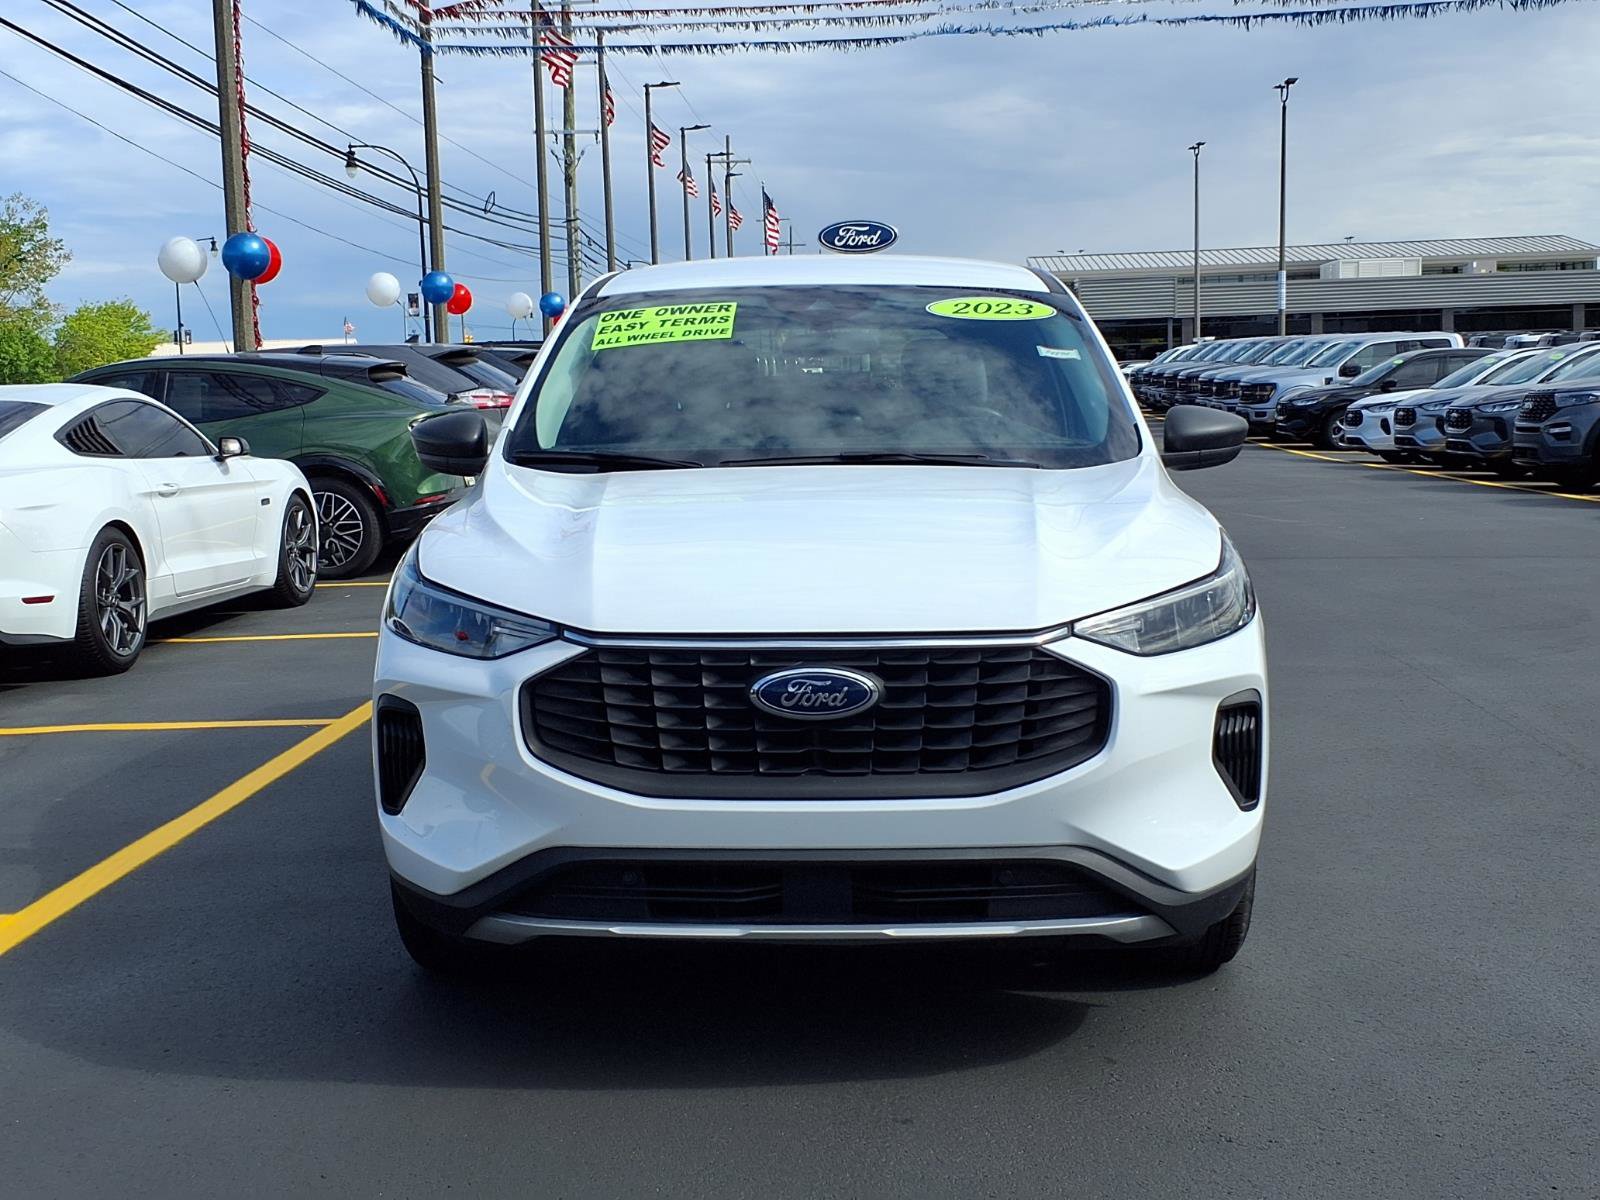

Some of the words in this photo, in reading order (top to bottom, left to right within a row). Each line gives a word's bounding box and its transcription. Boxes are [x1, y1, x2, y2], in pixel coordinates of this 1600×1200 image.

[834, 225, 882, 246] Ford
[601, 309, 646, 323] ONE
[654, 304, 732, 317] OWNER
[951, 302, 1034, 315] 2023
[597, 320, 650, 335] EASY
[659, 315, 731, 328] TERMS
[595, 337, 622, 347] ALL
[627, 331, 676, 342] WHEEL
[681, 327, 730, 337] DRIVE
[780, 678, 849, 707] Ford
